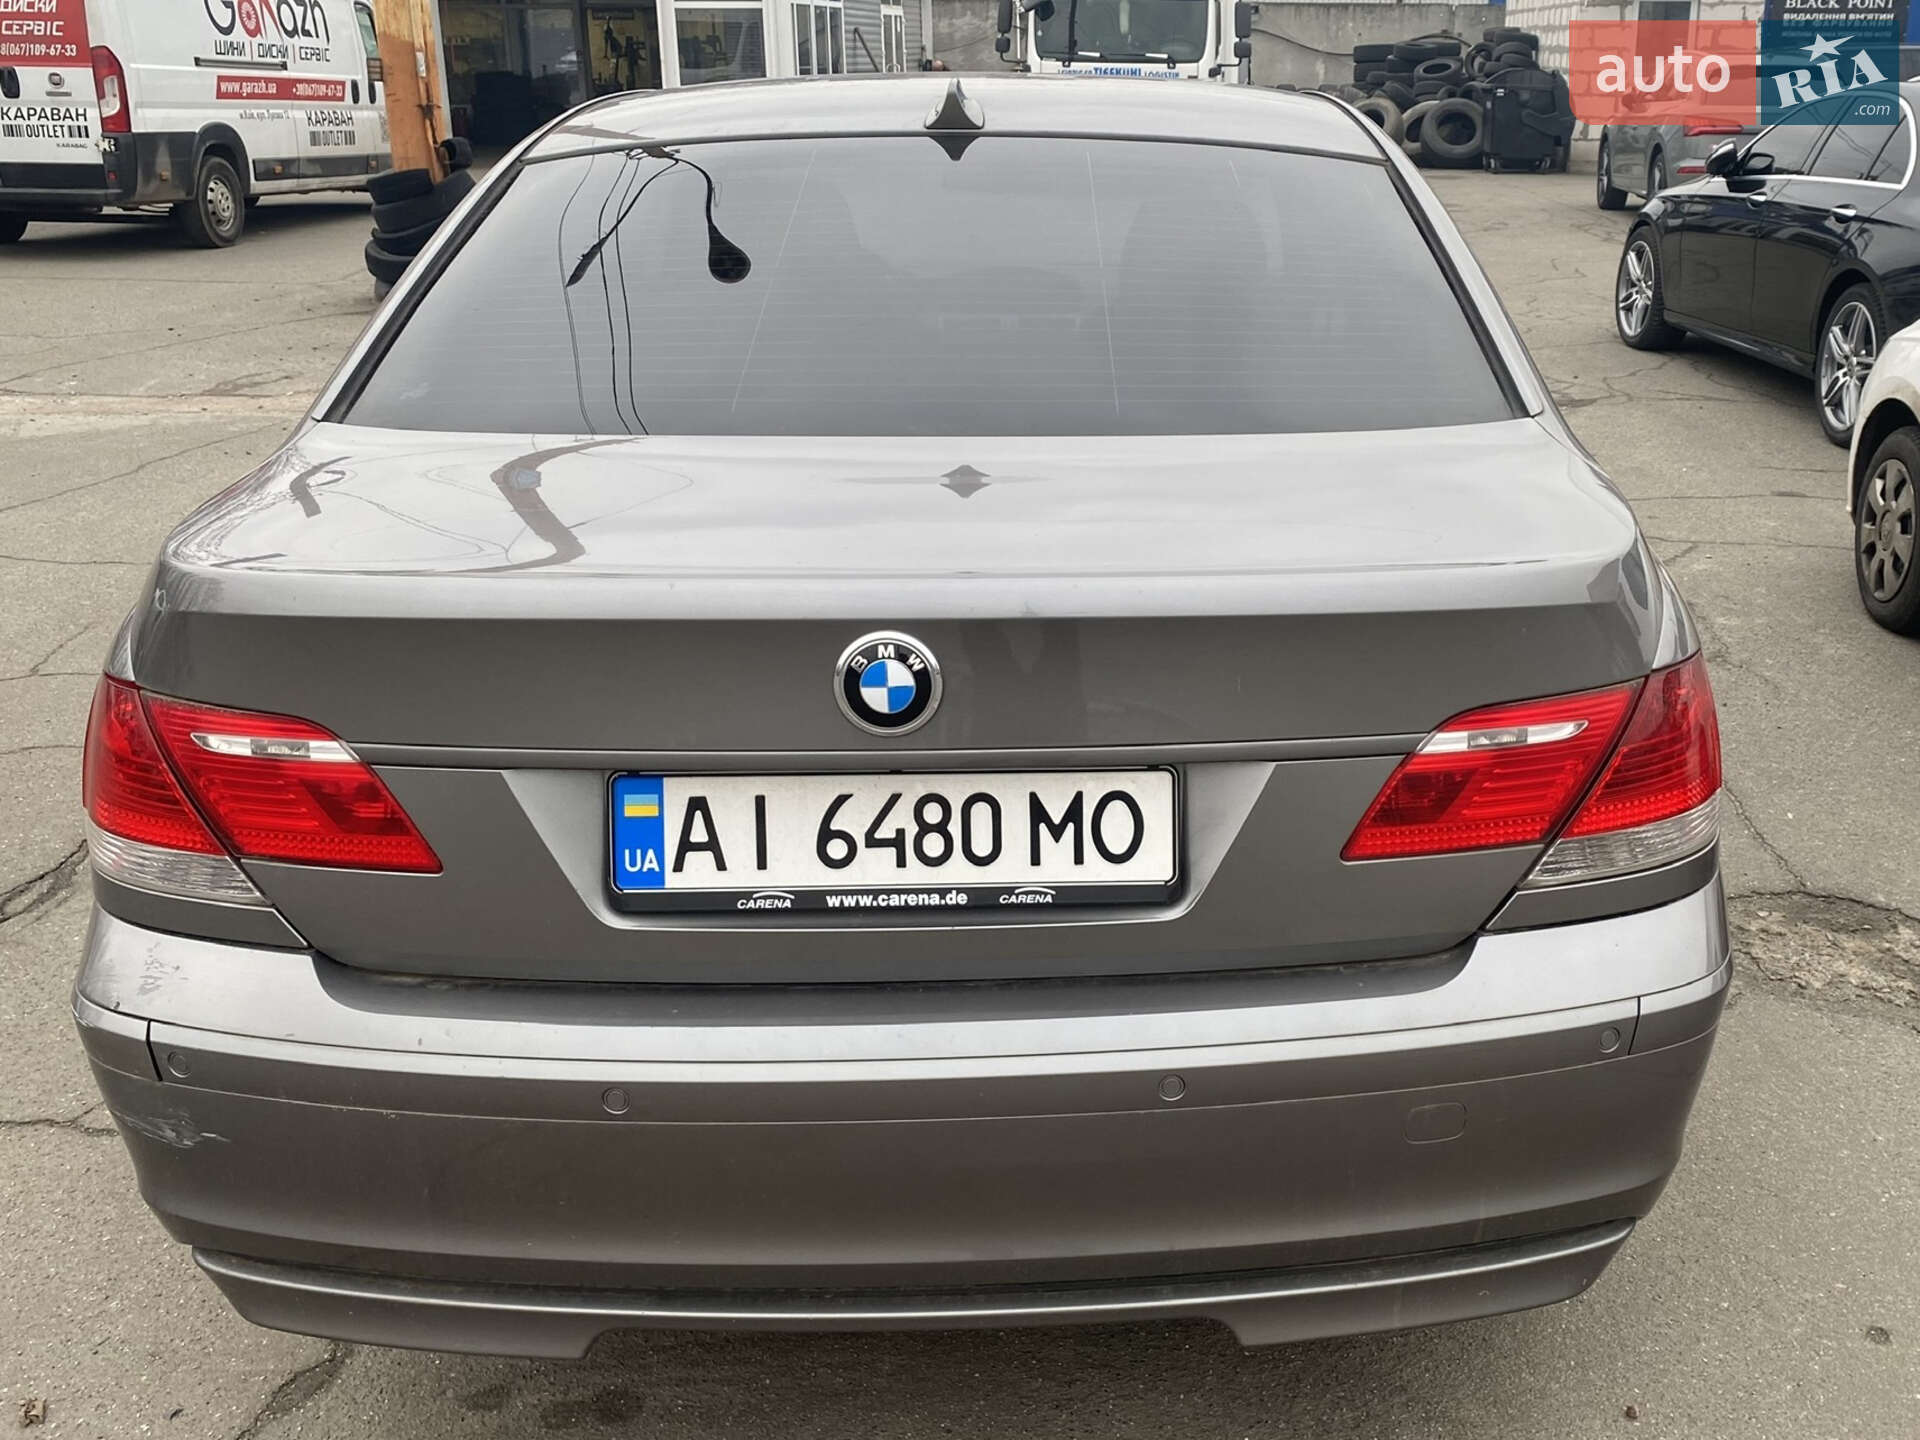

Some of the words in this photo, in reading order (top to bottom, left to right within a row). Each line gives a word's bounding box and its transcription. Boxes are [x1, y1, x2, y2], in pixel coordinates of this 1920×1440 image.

[1784, 0, 1841, 9] BLACK
[1847, 0, 1895, 9] POINT
[1, 20, 65, 36] СЕРВІС
[214, 39, 246, 56] ШИНИ
[257, 43, 289, 59] ДИСКИ
[299, 46, 331, 62] СЕРВІС
[220, 80, 277, 97] www.garazh.ua
[0, 106, 88, 122] КАРАВАН
[305, 109, 354, 127] КАРАВАН
[25, 124, 65, 139] OUTLET
[322, 130, 344, 146] OUTLET
[850, 644, 925, 674] BMW
[672, 795, 768, 873] AI
[815, 791, 1002, 870] 6480
[1029, 789, 1145, 867] MO
[624, 849, 660, 873] UA
[737, 899, 792, 909] CARENA
[826, 890, 969, 908] www.carena.de
[999, 894, 1054, 904] CARENA
